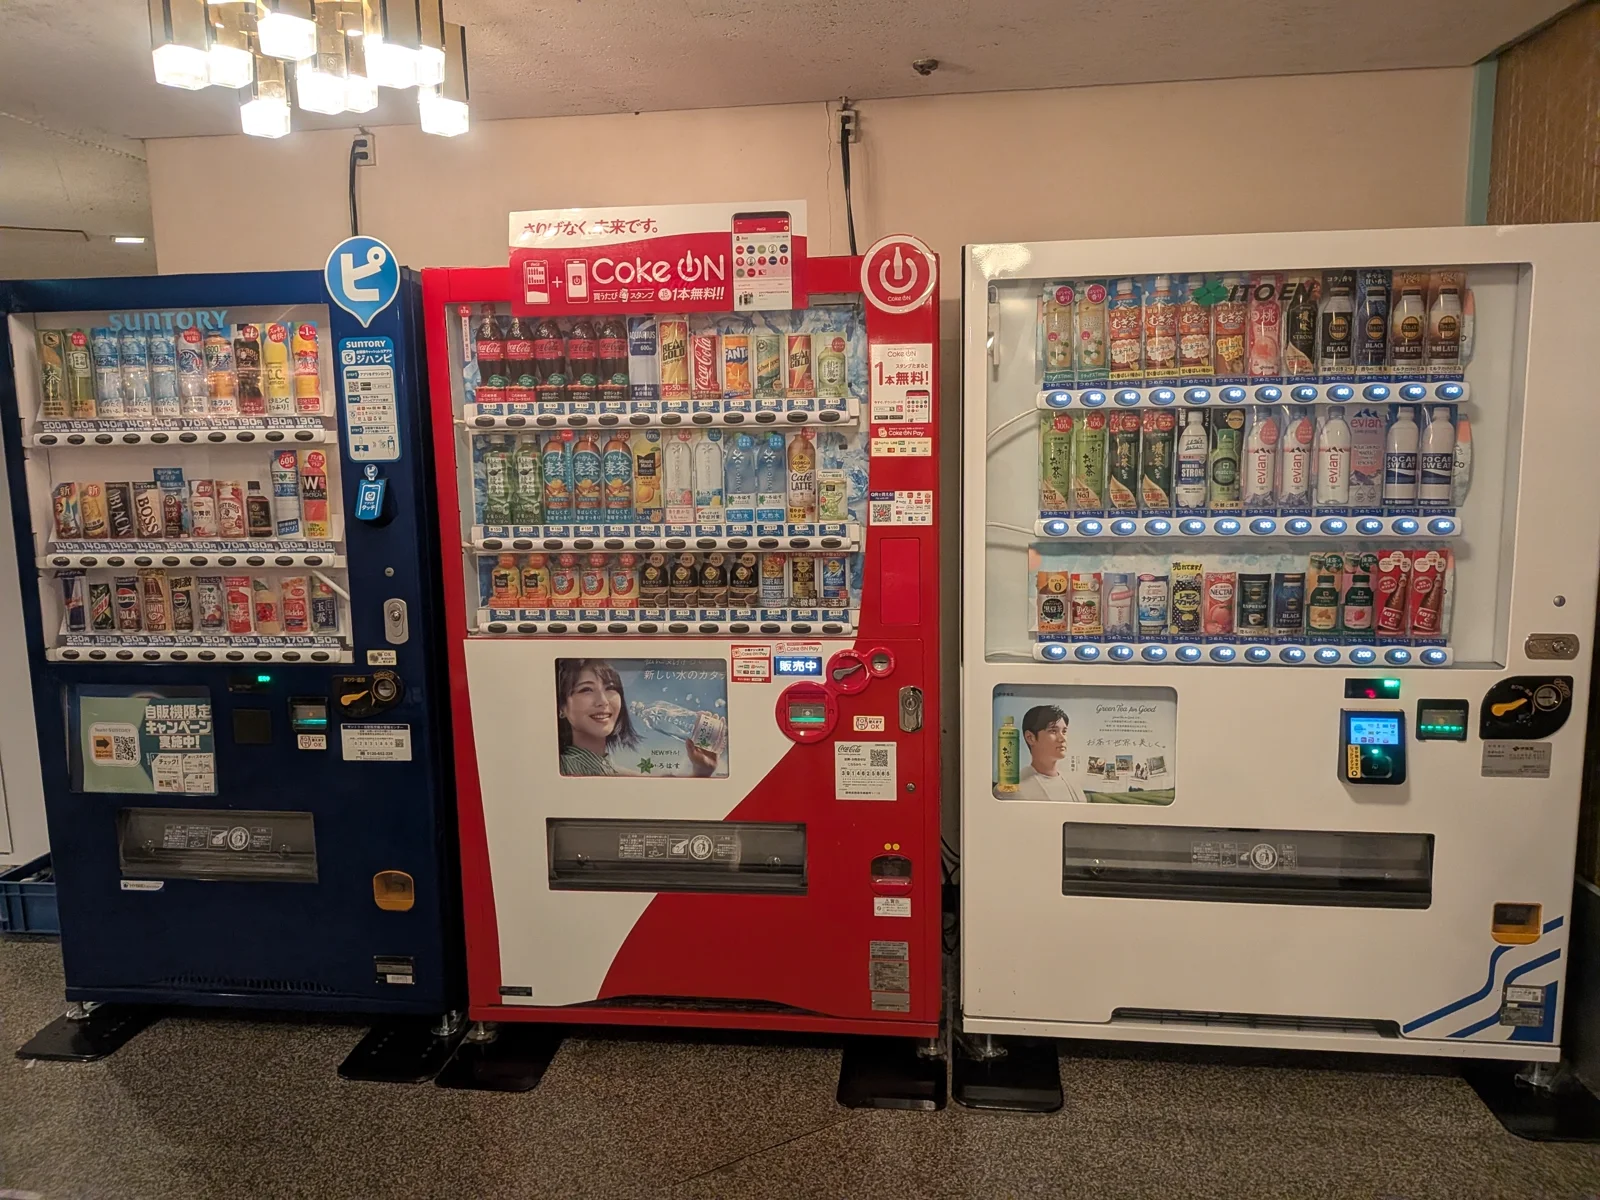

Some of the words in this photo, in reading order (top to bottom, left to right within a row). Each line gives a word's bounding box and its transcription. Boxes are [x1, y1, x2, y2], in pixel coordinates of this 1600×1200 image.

[522, 218, 658, 236] さりげなく、未来です。
[592, 256, 672, 284] Coke
[677, 250, 724, 282] ON
[340, 246, 387, 302] ピ
[593, 292, 618, 300] 買うたび
[630, 292, 654, 300] スタンプ
[672, 286, 724, 301] 1本無料!!
[1228, 284, 1275, 302] ITO
[1278, 282, 1316, 300] EN
[108, 310, 228, 331] SUNTORY
[1148, 314, 1174, 326] むぎ茶
[1182, 312, 1208, 324] むぎ茶
[1218, 310, 1244, 324] むぎ茶
[1260, 308, 1276, 322] 桃
[1112, 316, 1138, 328] むぎ茶
[662, 339, 686, 352] REAL
[356, 354, 392, 364] ジハンピ
[662, 349, 686, 362] GOLD
[790, 350, 810, 360] REAL
[694, 337, 712, 390] Coca-Cola
[790, 358, 810, 368] GOLD
[874, 361, 930, 386] 1本無料!
[43, 421, 68, 429] 200円
[99, 420, 124, 428] 140円
[210, 418, 236, 426] 150円
[266, 418, 293, 426] 180円
[1350, 418, 1384, 428] evian
[280, 456, 294, 465] 600
[574, 460, 600, 476] 麦茶
[604, 460, 630, 476] 麦茶
[1182, 468, 1204, 478] STRONG
[1256, 454, 1266, 484] evian
[1292, 454, 1302, 484] evian
[1328, 453, 1338, 484] evian
[304, 476, 318, 490] W
[791, 472, 812, 482] Café
[88, 486, 98, 496] 新
[790, 482, 812, 492] LATTE
[138, 496, 159, 533] BOSS
[1172, 562, 1202, 571] 売れてます!
[780, 660, 817, 672] 販売中
[145, 704, 212, 719] 自販機限定
[1096, 704, 1116, 714] Green
[1116, 702, 1128, 712] Tea
[1138, 704, 1156, 714] Good
[146, 720, 212, 734] キャンペーン
[159, 736, 200, 748] 実施中!
[1086, 738, 1166, 748] お茶で世界を美しく。
